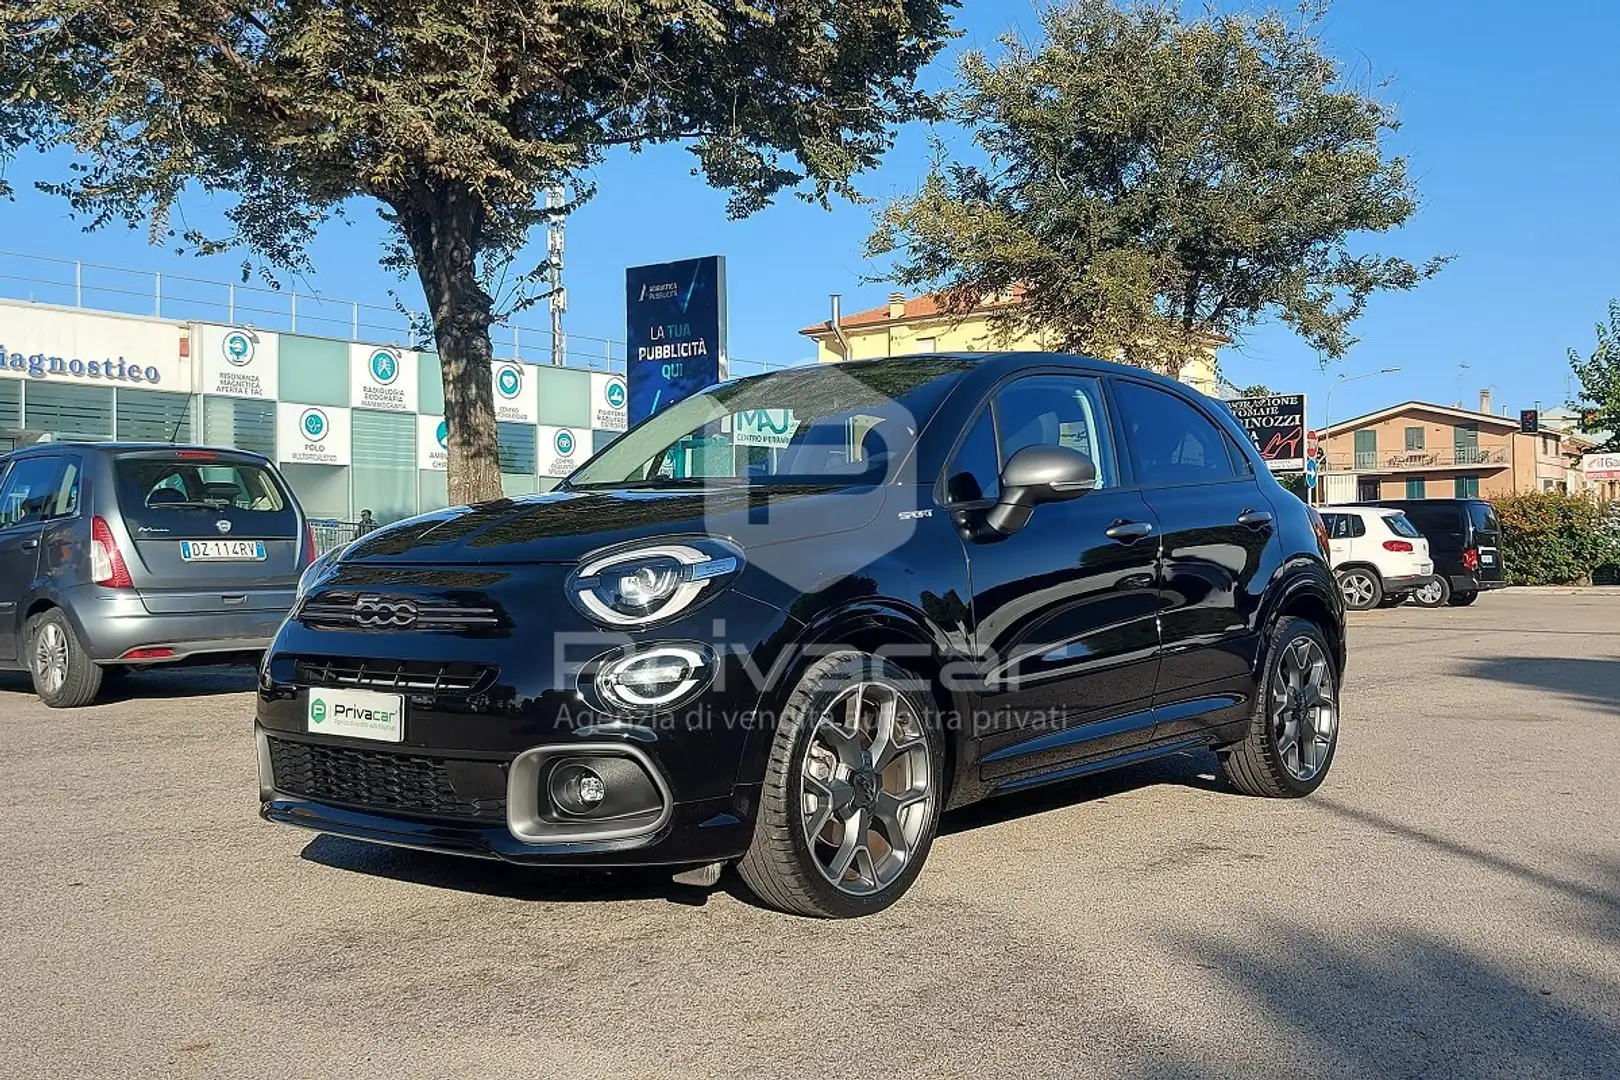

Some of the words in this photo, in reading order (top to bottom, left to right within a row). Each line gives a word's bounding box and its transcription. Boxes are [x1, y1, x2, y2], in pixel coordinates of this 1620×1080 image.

[650, 326, 664, 340] LA
[667, 323, 691, 338] TUA
[638, 338, 707, 361] PUBBLICITÀ
[661, 363, 683, 380] QUI
[304, 444, 326, 452] POLO
[192, 543, 210, 556] DZ
[214, 543, 255, 556] 114RV
[334, 703, 396, 722] Privacar
